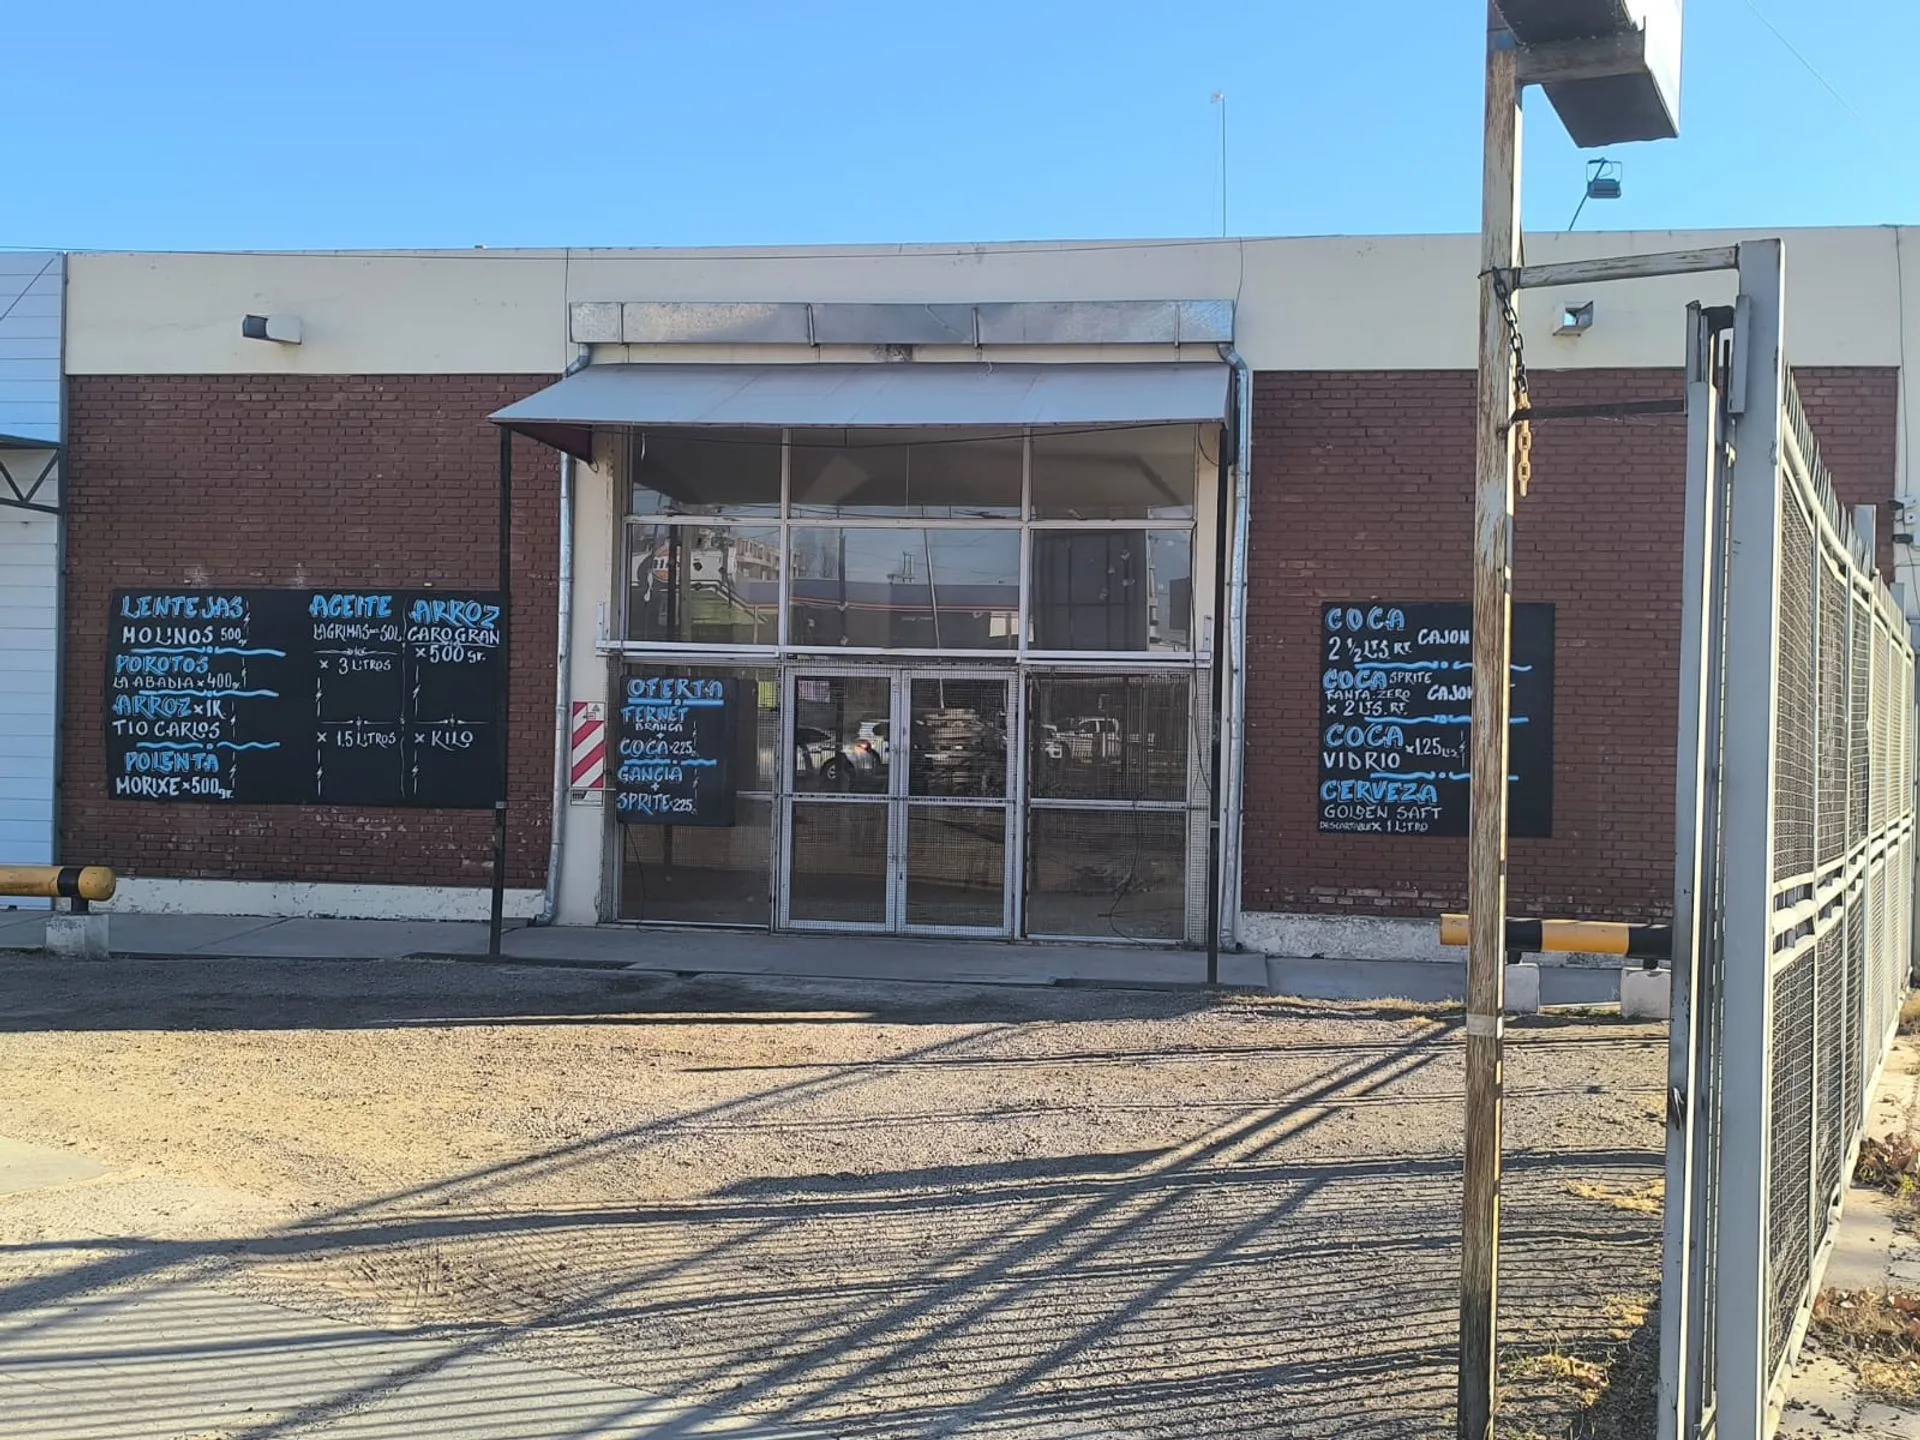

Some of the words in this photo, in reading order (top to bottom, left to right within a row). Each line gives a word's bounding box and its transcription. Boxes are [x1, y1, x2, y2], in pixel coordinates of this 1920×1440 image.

[121, 595, 244, 619] LENTEJAS
[309, 594, 392, 619] ACEITE
[408, 599, 500, 629] ARROZ
[1325, 606, 1406, 631] COCA
[122, 625, 213, 645] MOLINOS
[313, 623, 370, 641] LAGRIMAS
[380, 624, 402, 641] SOL
[1418, 628, 1470, 645] CAJON
[116, 654, 209, 675] POROTOS
[339, 657, 348, 675] 3
[352, 659, 392, 672] LITROS
[113, 676, 129, 689] LA
[132, 676, 194, 689] ABADIA
[627, 677, 723, 698] OFERTA
[1323, 668, 1387, 690] COCA
[1389, 671, 1433, 685] SPRITE
[112, 694, 192, 719] ARROZ
[621, 705, 689, 722] FERNET
[1343, 700, 1356, 716] 2
[112, 719, 148, 736] TIO
[154, 721, 220, 740] CARLOS
[635, 723, 683, 732] BRANCA
[1325, 723, 1404, 748] COCA
[337, 730, 353, 747] 1.5
[356, 732, 396, 748] LITROS
[431, 730, 474, 751] KILO
[619, 738, 669, 757] COCA
[125, 750, 219, 773] POLENTA
[1323, 752, 1400, 772] VIDRIO
[618, 766, 683, 782] GANCIA
[115, 776, 181, 798] MORIXE
[1320, 779, 1438, 804] CERVEZA
[617, 792, 671, 815] SPRITE
[1324, 804, 1388, 820] GOLDEN
[1396, 806, 1442, 820] SAFT
[1387, 820, 1392, 832] 1
[1395, 820, 1429, 833] LITRO
